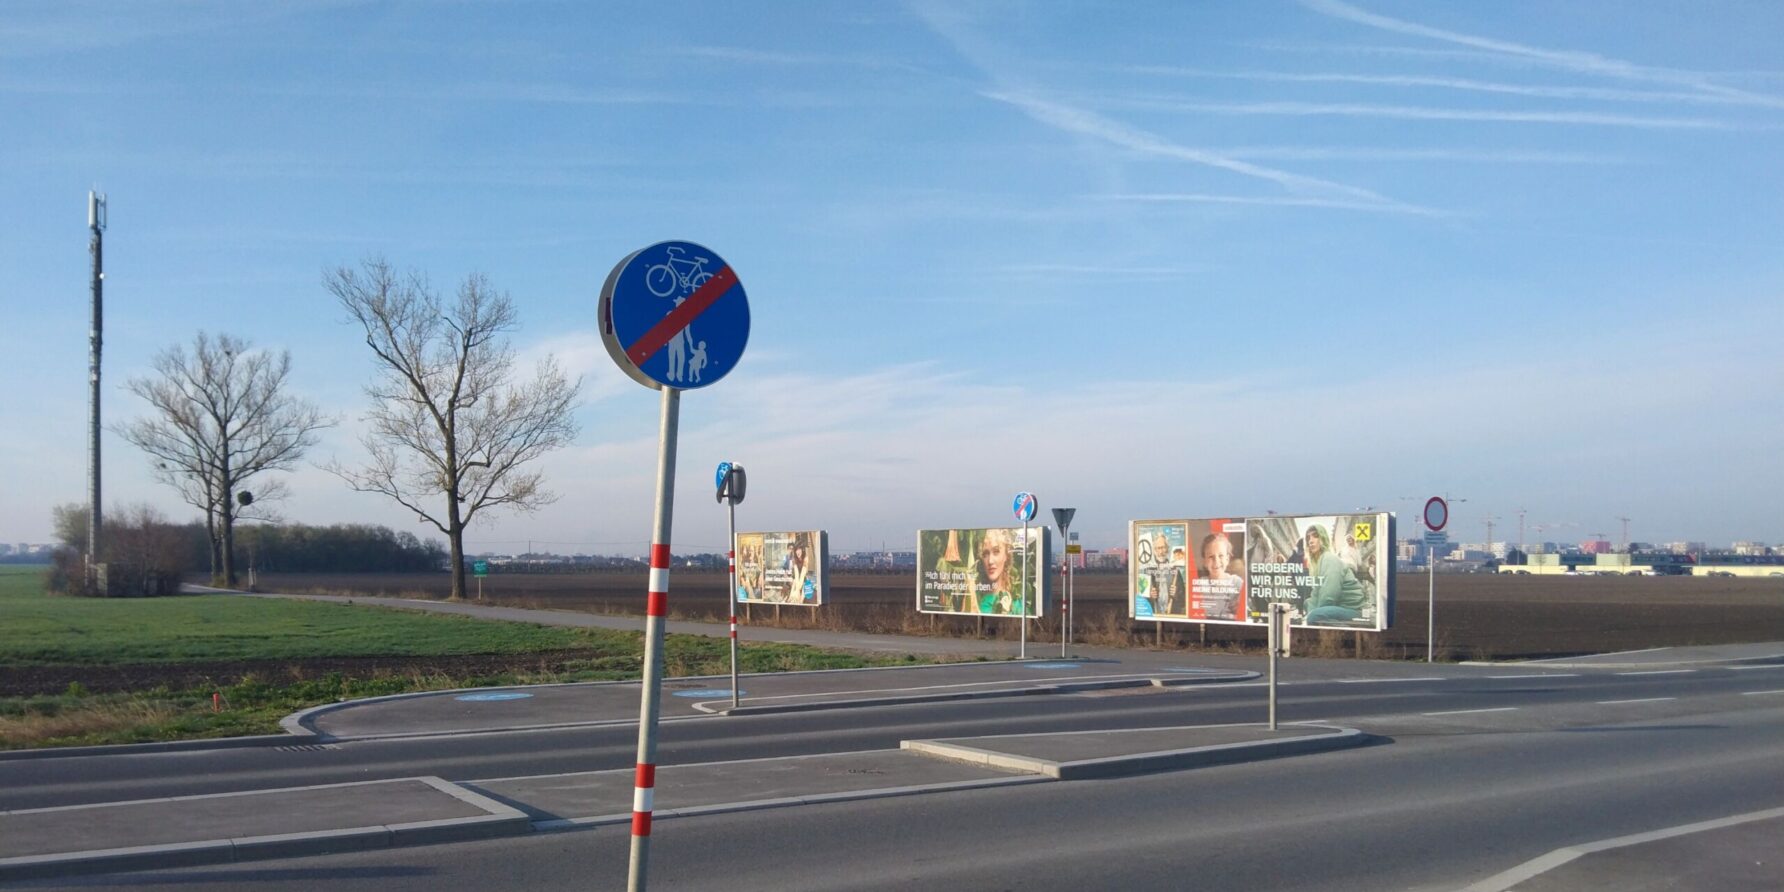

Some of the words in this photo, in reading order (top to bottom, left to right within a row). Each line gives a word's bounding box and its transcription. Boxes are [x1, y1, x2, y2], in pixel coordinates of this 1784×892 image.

[1251, 562, 1304, 573] EROBERN
[952, 572, 965, 580] mich
[1251, 576, 1271, 586] WIR
[1274, 576, 1292, 586] DIE
[1294, 576, 1324, 586] WELT
[934, 582, 957, 590] Paradies
[1251, 585, 1272, 598] FÜR
[1275, 588, 1301, 598] UNS.
